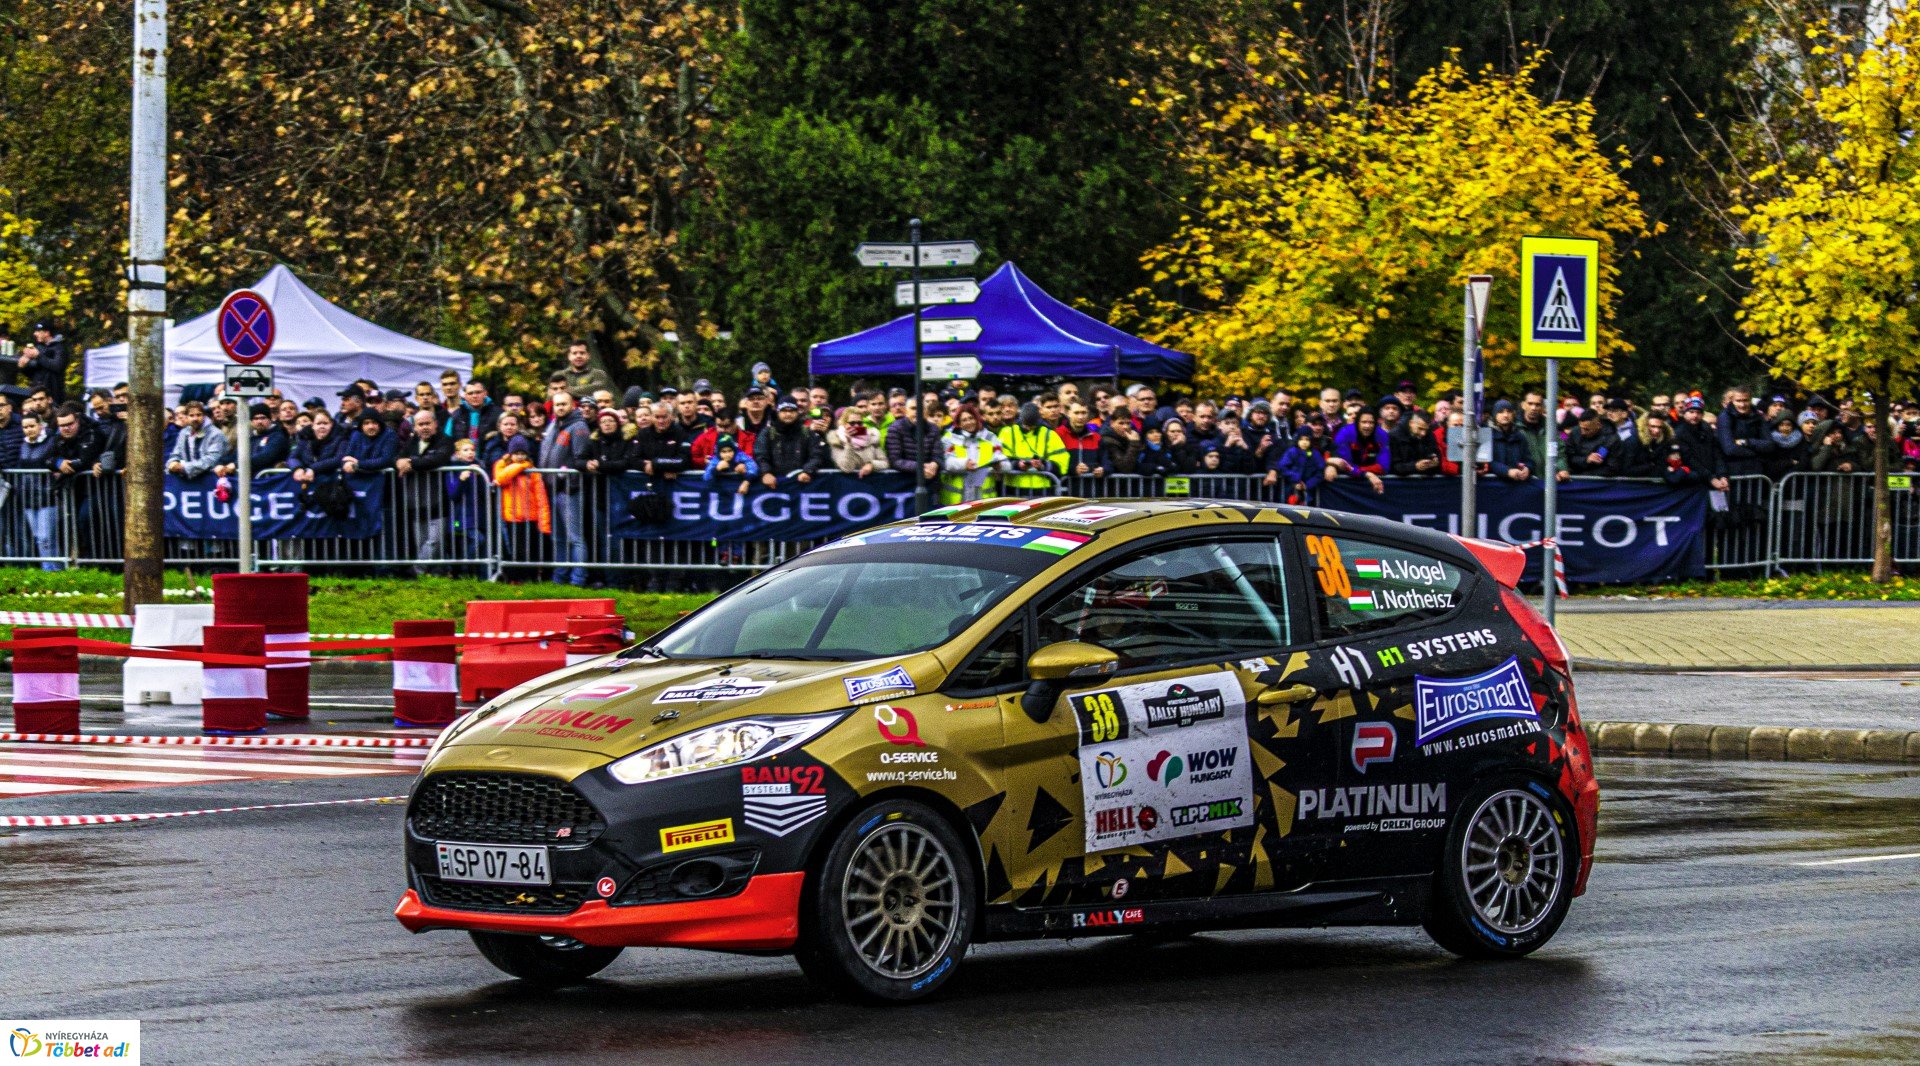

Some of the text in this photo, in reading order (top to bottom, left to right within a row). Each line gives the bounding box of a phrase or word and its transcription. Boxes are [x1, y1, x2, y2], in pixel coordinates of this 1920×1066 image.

[164, 490, 367, 521] PEUGE
[630, 490, 915, 522] EUGEOT
[890, 525, 1032, 539] SEAJETS
[1402, 512, 1681, 548] EUGEOT
[1306, 535, 1352, 599] 38
[1381, 560, 1446, 584] A.Vogel
[1372, 589, 1455, 610] I.Notheisz
[1377, 628, 1497, 668] H1 SYSTEMS
[849, 671, 910, 695] Eurosmart
[1148, 704, 1178, 722] RALLY
[1179, 696, 1221, 718] HUNGARY
[1423, 673, 1529, 727] Eurosmart
[495, 708, 634, 734] ATINUM
[1083, 693, 1119, 743] 38
[1423, 719, 1542, 758] www.eurosmart.hu
[881, 752, 938, 764] Q-SERVICE
[1188, 747, 1237, 773] WOW
[867, 768, 957, 783] www.q-service.hu
[1190, 769, 1232, 784] HUNGARY
[744, 785, 791, 794] SYSTEME
[1298, 783, 1446, 820] PLATINUM
[1096, 806, 1136, 833] HELL
[1344, 819, 1446, 833] powered by ORLEN GROUP
[665, 823, 727, 847] PIRELLI
[454, 848, 545, 880] SP 07-84
[1072, 910, 1125, 928] RALLY
